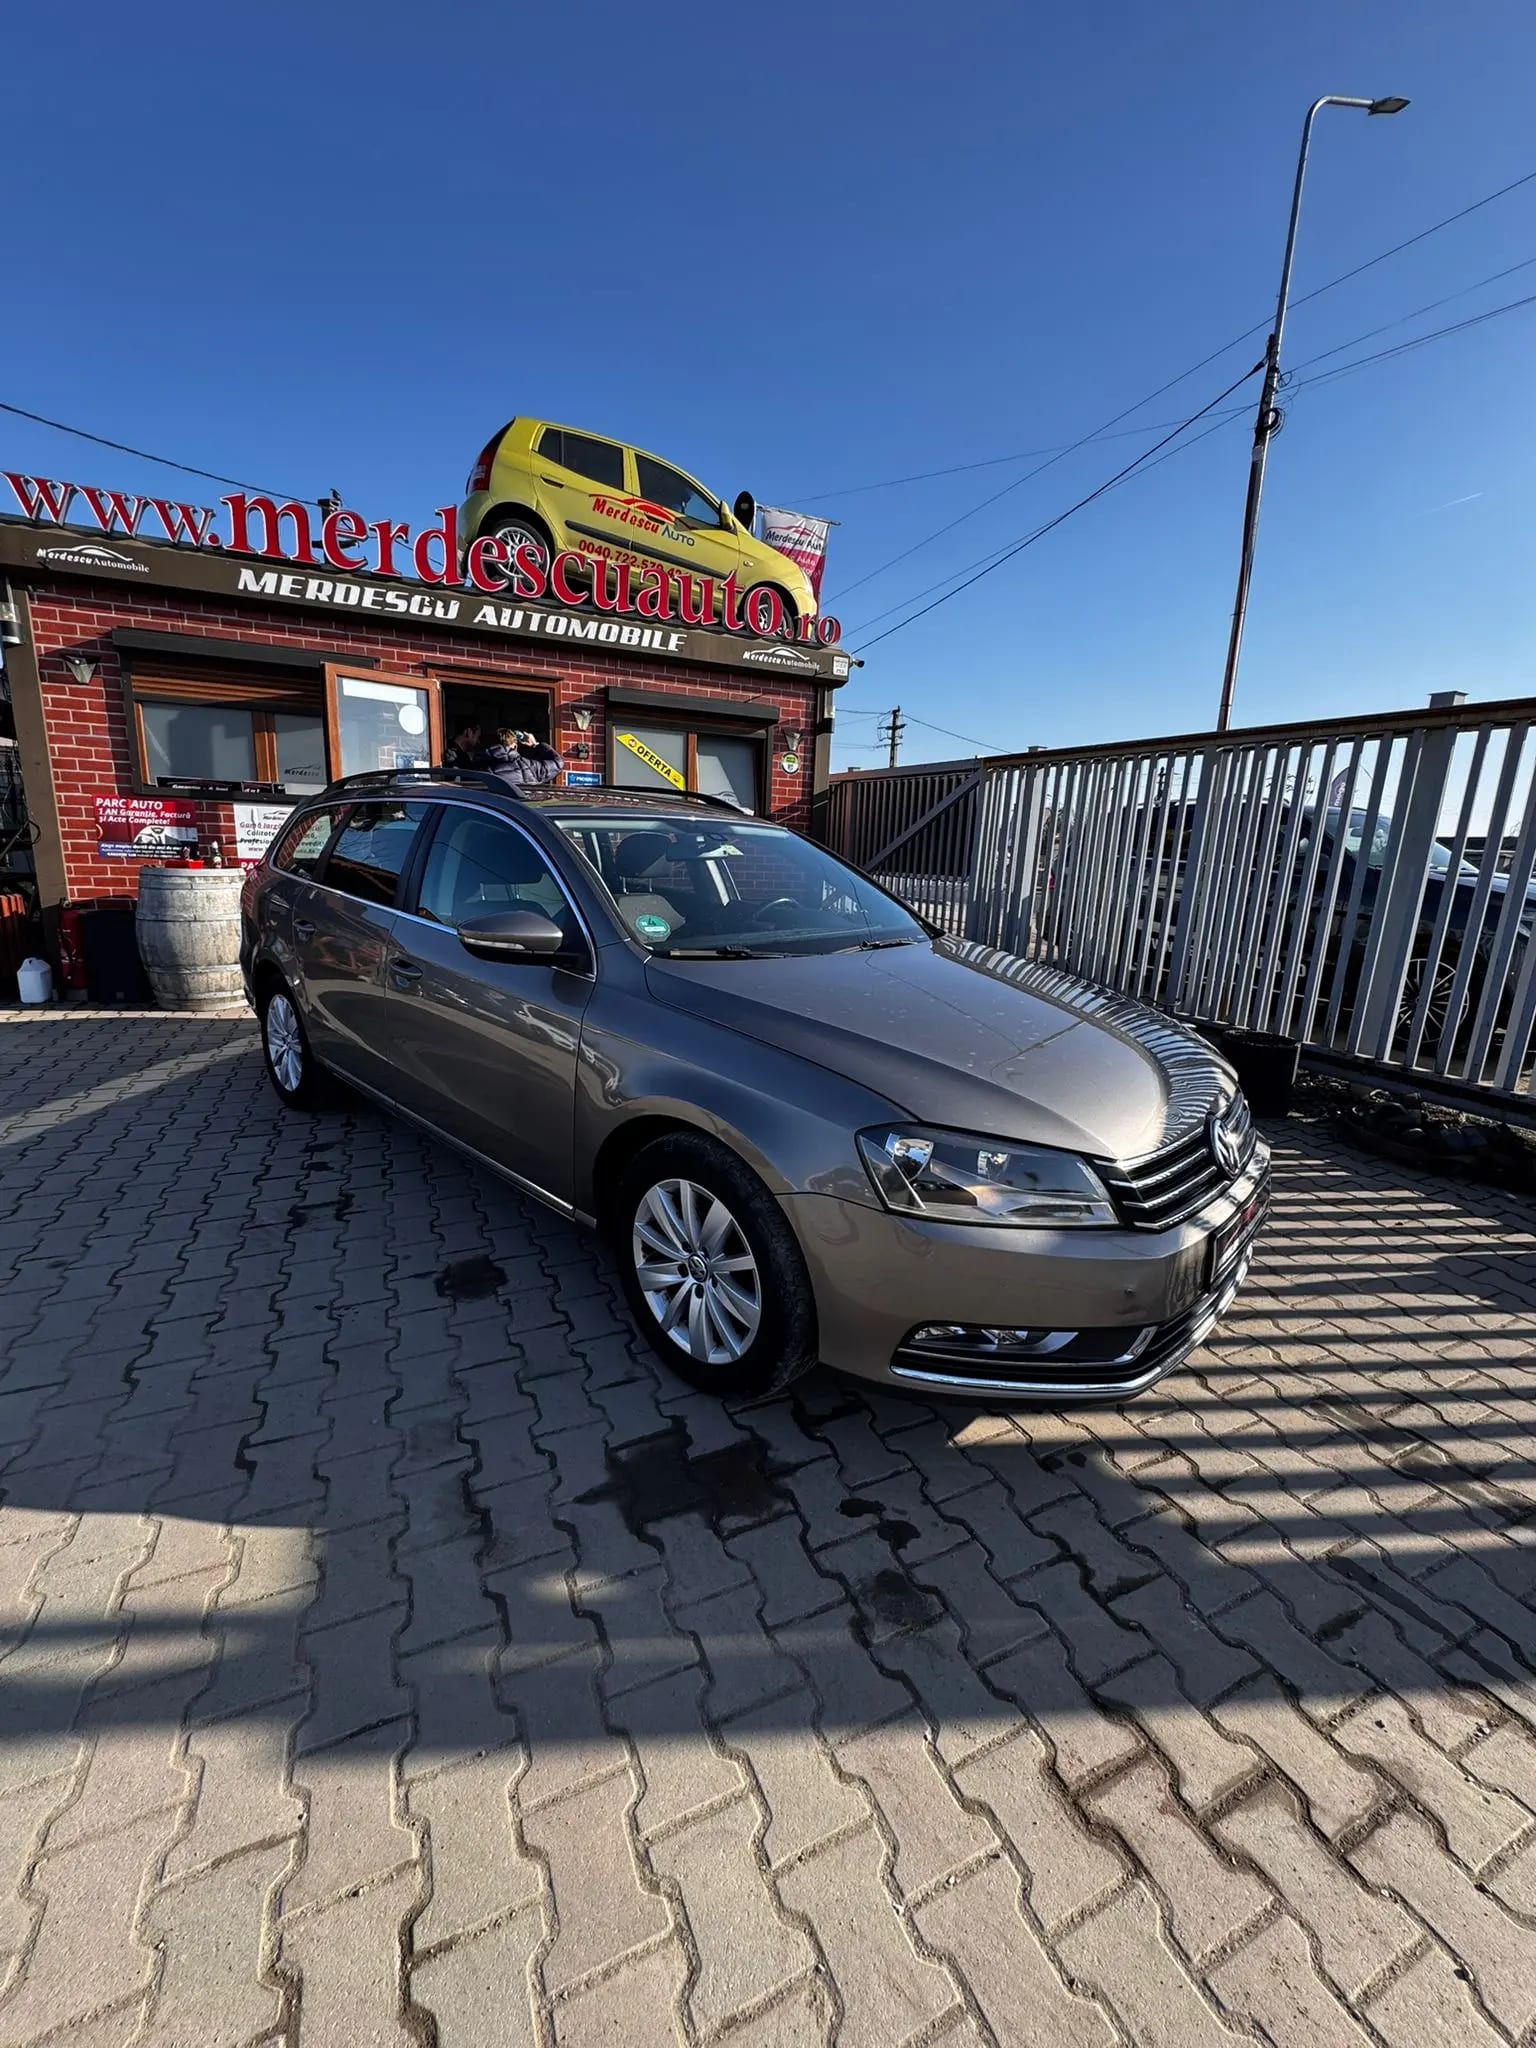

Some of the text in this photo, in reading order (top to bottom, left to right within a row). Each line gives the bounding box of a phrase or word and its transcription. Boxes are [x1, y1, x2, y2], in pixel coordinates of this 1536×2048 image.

[592, 498, 695, 546] Merdescu AUTO
[0, 471, 842, 646] www.merdescuauto.ro
[237, 567, 688, 652] MERDESCU AUTOMOBILE
[637, 746, 672, 777] OFERTA
[96, 798, 163, 810] PARC AUTO
[105, 808, 118, 816] AN
[128, 816, 170, 825] Complete!
